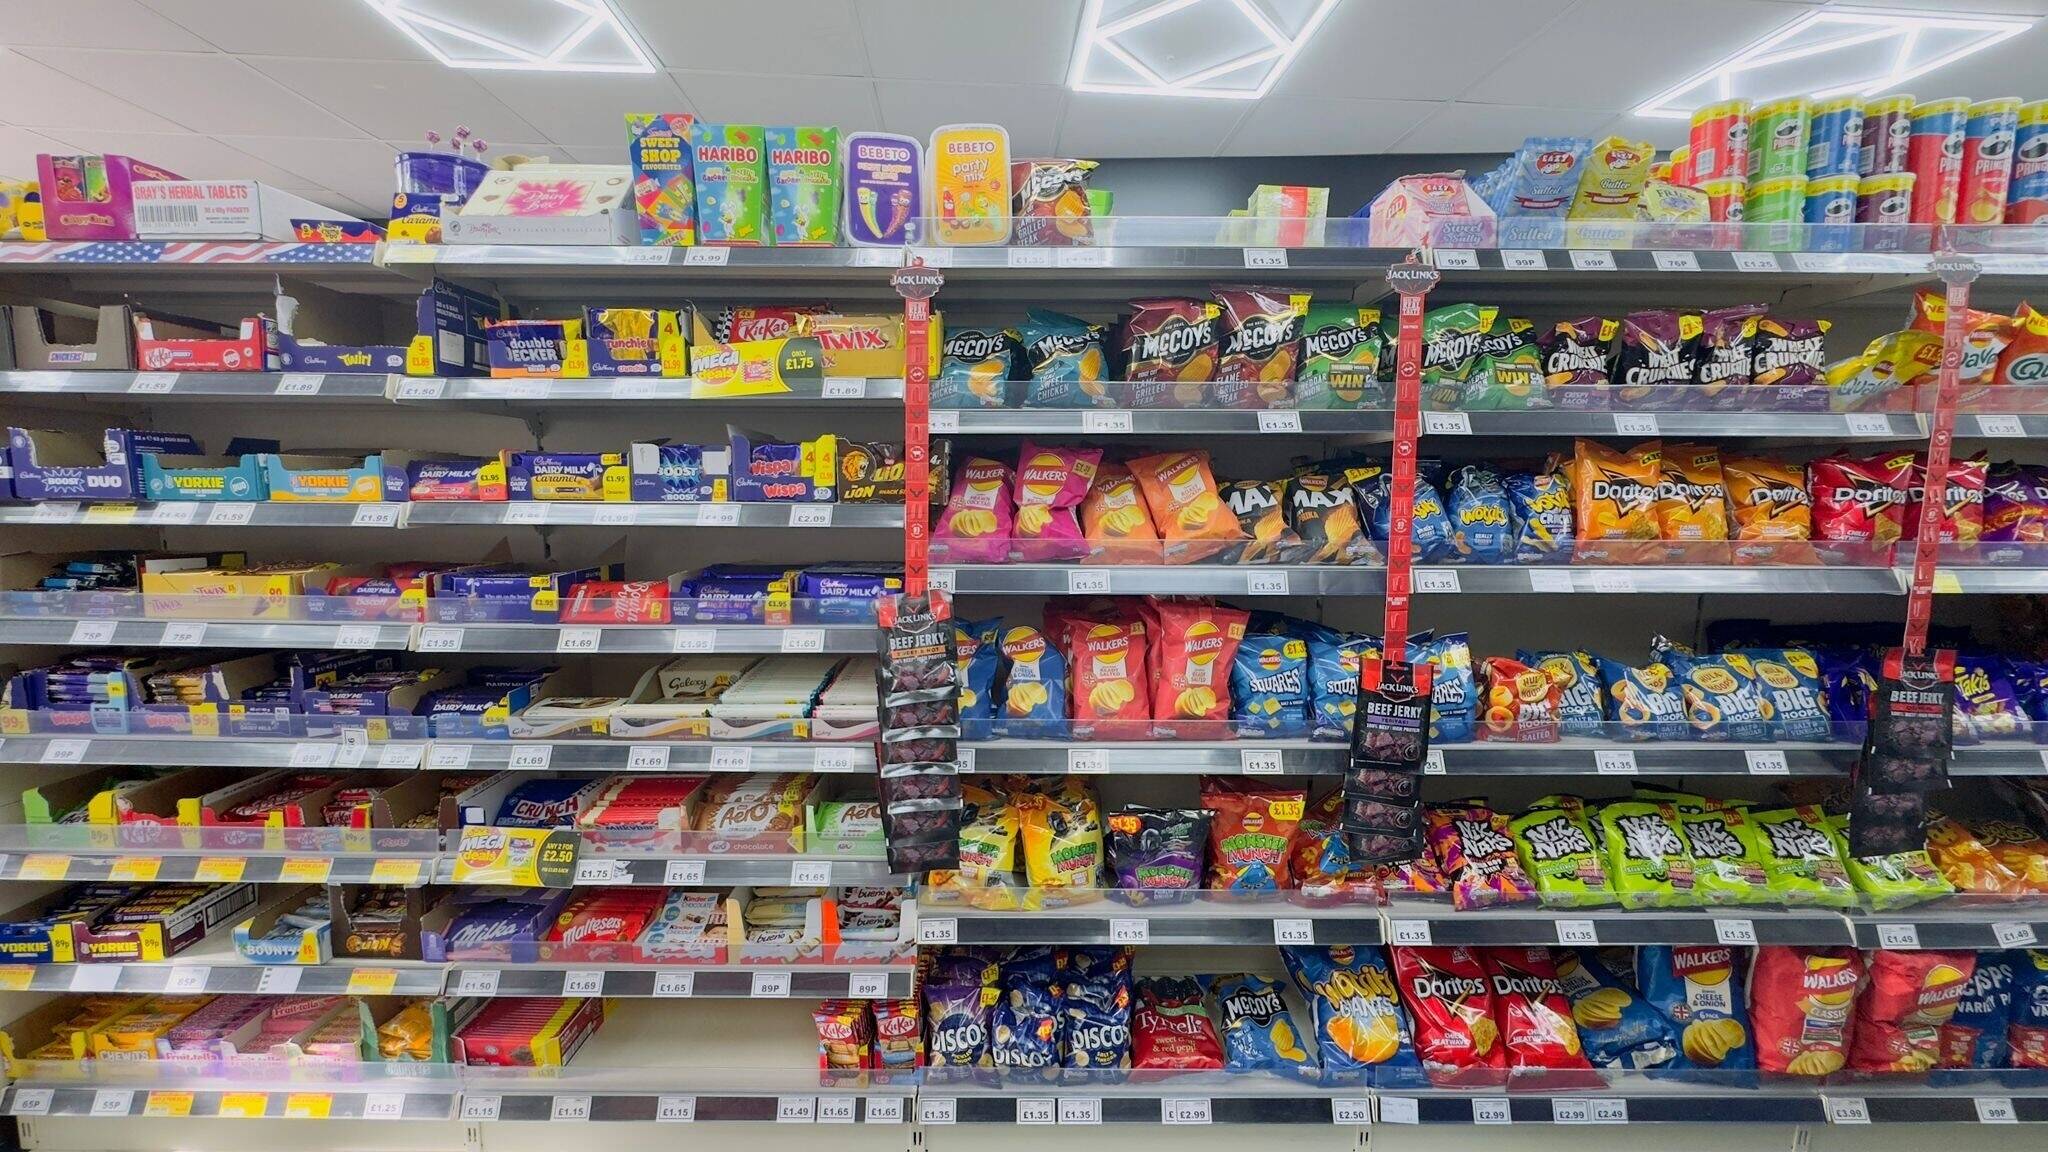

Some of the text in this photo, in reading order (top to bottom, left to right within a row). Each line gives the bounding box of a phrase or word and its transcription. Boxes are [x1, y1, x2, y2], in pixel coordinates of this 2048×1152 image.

[640, 137, 680, 149] SWEET
[948, 141, 995, 154] BEBETO
[641, 149, 679, 163] SHOP
[698, 147, 758, 163] HARIBO
[772, 149, 831, 165] HARIBO
[858, 145, 909, 159] BEBETO
[953, 160, 989, 175] party
[963, 171, 986, 183] mix
[168, 185, 205, 200] HERBAL
[207, 185, 248, 200] TABLETS
[1448, 257, 1468, 265] 99P
[1386, 270, 1410, 280] JACK
[664, 322, 674, 334] 4
[741, 320, 789, 337] KitKat
[511, 337, 555, 350] double
[814, 331, 886, 349] TWIX
[791, 350, 807, 358] ONLY
[693, 352, 740, 370] MEGA
[785, 356, 815, 370] £1.75
[1330, 375, 1363, 388] WIN
[1097, 421, 1126, 430] £1.35
[1266, 421, 1294, 430] £1.35
[1432, 421, 1461, 430] £1.35
[1623, 424, 1653, 432] £1.35
[534, 466, 587, 474] DAIRY MILK
[1023, 469, 1067, 482] WALKERS
[48, 477, 79, 486] BOOST
[87, 476, 122, 487] DUO
[173, 476, 225, 488] YORKIE
[763, 483, 806, 498] Wispa
[360, 514, 389, 522] £1.95
[820, 578, 848, 590] Cadbury
[1075, 581, 1103, 589] £1.35
[1254, 582, 1281, 590] £1.35
[1424, 580, 1451, 589] £1.35
[820, 587, 872, 597] DAIRY MILK
[426, 639, 455, 648] £1.95
[564, 639, 592, 648] £1.69
[889, 632, 945, 650] BEEF JERKY
[1002, 638, 1045, 654] WALKERS
[1087, 637, 1129, 651] WALKERS
[1184, 637, 1223, 653] WALKERS
[668, 677, 707, 691] Galaxy
[1250, 669, 1302, 694] SQUARES
[1376, 681, 1419, 694] JACK LINK'S
[1716, 690, 1753, 713] BIG
[1774, 687, 1810, 710] BIG
[1890, 690, 1944, 704] BEEF JERKY
[1367, 702, 1422, 719] BEEF JERKY
[1781, 708, 1821, 720] HOOPS
[1728, 710, 1760, 722] HOOPS
[516, 756, 543, 765] £1.69
[634, 758, 661, 766] £1.69
[1249, 762, 1276, 770] £1.35
[1604, 762, 1632, 770] £1.35
[1755, 762, 1783, 770] £1.35
[515, 797, 579, 819] CRUNCH
[1272, 802, 1301, 817] £1.35
[459, 835, 506, 852] MEGA
[542, 850, 574, 864] £2.50
[1226, 849, 1290, 867] MUNCH
[581, 869, 608, 878] £1.75
[672, 872, 699, 881] £1.65
[799, 873, 825, 881] £1.65
[683, 894, 708, 903] Kinder
[858, 889, 887, 899] bueno
[856, 917, 887, 928] bueno
[452, 920, 519, 945] Milka
[563, 913, 622, 948] Maltesers
[925, 930, 951, 939] £1.35
[1117, 931, 1143, 939] £1.35
[1282, 931, 1308, 939] £1.35
[1400, 931, 1426, 939] £1.35
[1565, 931, 1592, 939] £1.35
[1724, 930, 1751, 939] £1.35
[2003, 930, 2029, 940] £1.49
[55, 936, 70, 948] 89p
[144, 936, 160, 948] 89p
[757, 931, 786, 943] bueno
[1887, 935, 1914, 943] £1.49
[89, 942, 139, 954] YORKIE
[247, 944, 300, 956] BOUNTY
[1675, 949, 1732, 967] WALKERS
[1804, 968, 1858, 989] WALKERS
[570, 982, 596, 990] £1.69
[660, 984, 686, 992] £1.65
[761, 984, 780, 993] 89P
[859, 985, 877, 994] 89P
[1413, 976, 1486, 999] Doritos
[1695, 994, 1724, 1002] CHEESE
[1699, 1000, 1727, 1008] ONION
[1810, 1006, 1848, 1018] CLASSIC
[822, 1021, 852, 1039] KitKat
[933, 1022, 988, 1052] DISCOS
[22, 1101, 41, 1109] 65P
[103, 1101, 120, 1109] 55P
[371, 1104, 397, 1112] £1.25
[468, 1107, 494, 1116] £1.15
[558, 1107, 584, 1116] £1.15
[663, 1108, 689, 1116] £1.15
[783, 1107, 809, 1116] £1.49
[823, 1107, 849, 1116] £1.65
[871, 1108, 897, 1116] £1.65
[925, 1110, 951, 1119] £1.35
[1024, 1110, 1049, 1119] £1.35
[1065, 1110, 1091, 1119] £1.35
[1180, 1110, 1205, 1119] £2.99
[1339, 1110, 1365, 1119] £2.50
[1479, 1110, 1505, 1119] £2.99
[1559, 1110, 1585, 1119] £2.99
[1597, 1110, 1623, 1119] £2.49
[1836, 1109, 1862, 1117] £3.99
[1989, 1109, 2006, 1117] 99P
